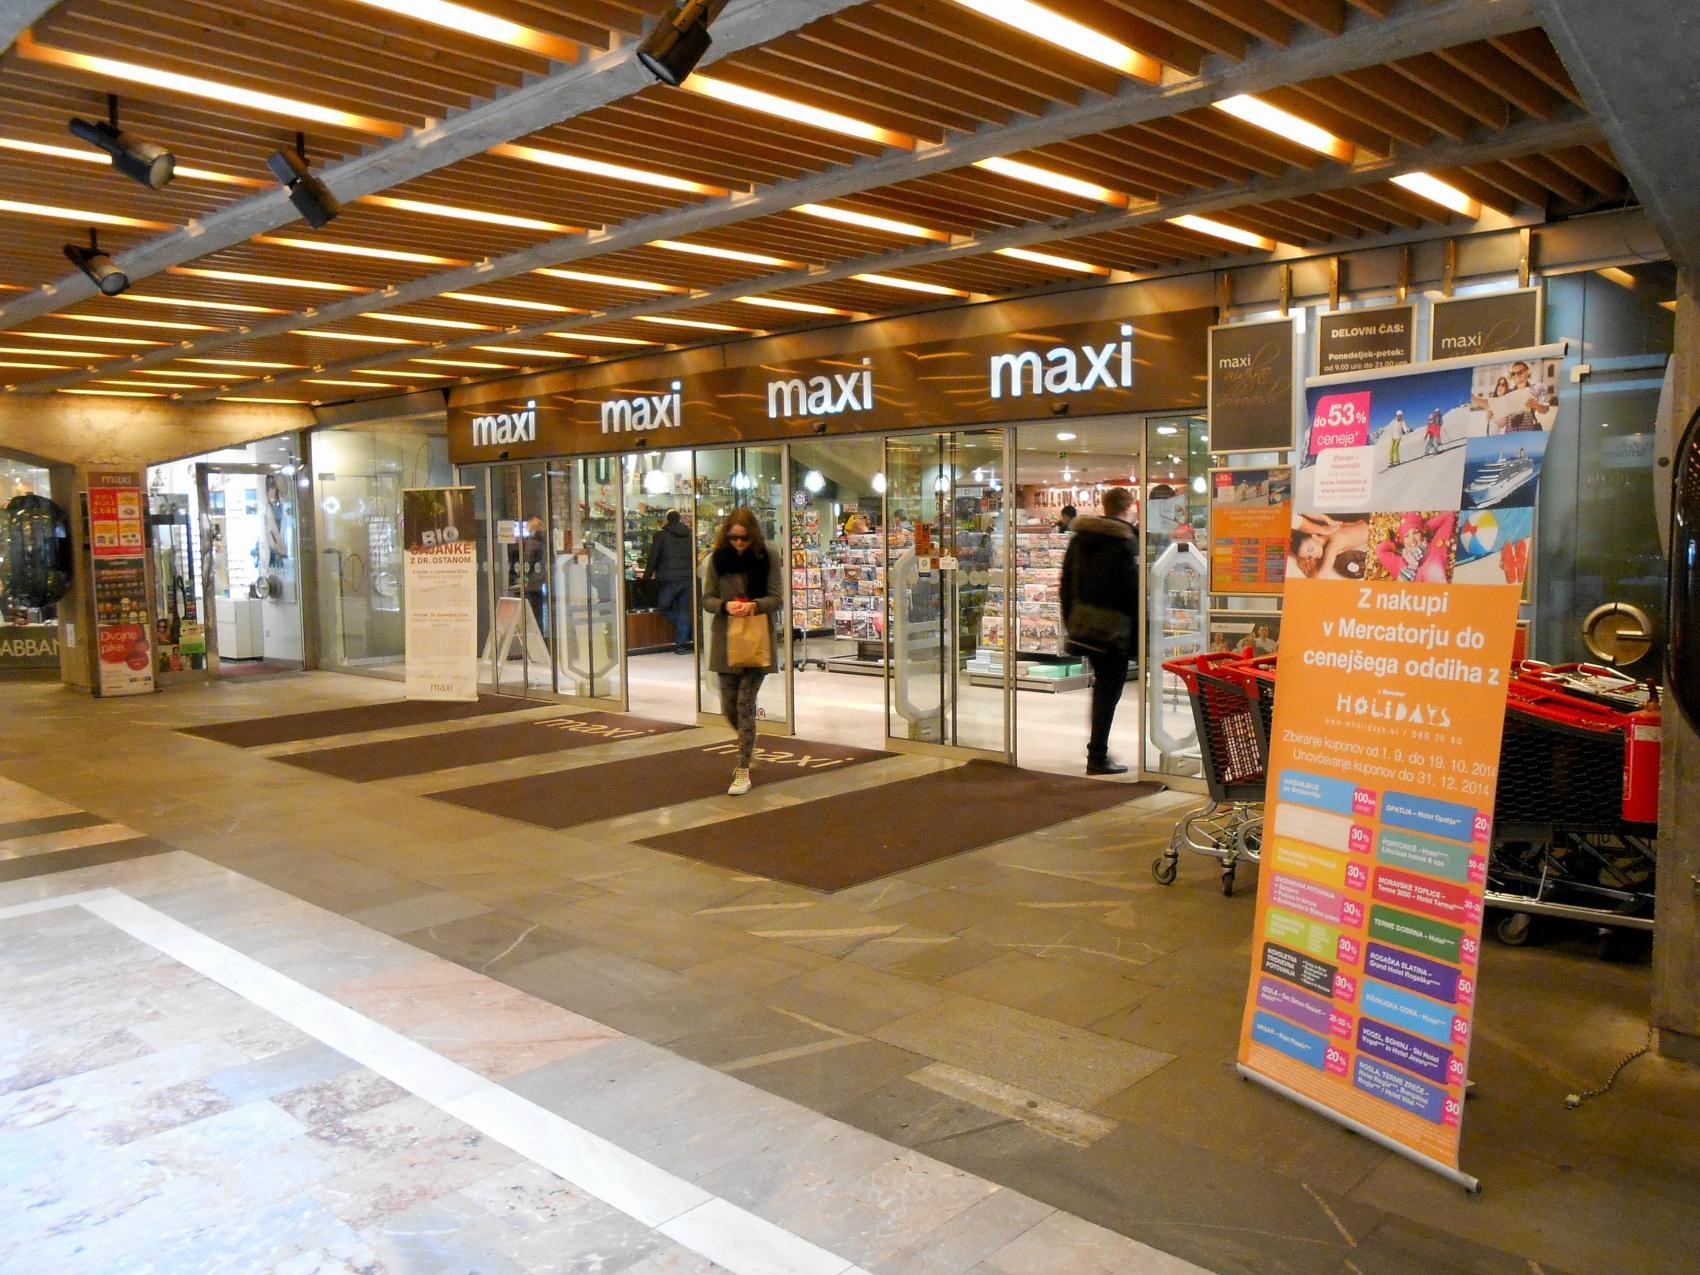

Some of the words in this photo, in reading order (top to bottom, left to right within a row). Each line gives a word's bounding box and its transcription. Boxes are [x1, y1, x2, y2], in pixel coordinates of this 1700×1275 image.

[1331, 327, 1376, 338] DELOVNI
[1379, 323, 1404, 334] ČAS:
[1441, 331, 1482, 349] maxi
[990, 324, 1132, 397] maxi
[1219, 353, 1252, 369] maxi
[1328, 348, 1404, 361] Ponedeljek-petek:
[1323, 363, 1334, 372] od
[1335, 362, 1349, 371] 9.00
[1363, 361, 1373, 370] do
[768, 357, 872, 418] maxi
[601, 380, 681, 434] maxi
[472, 400, 536, 446] maxi
[1313, 415, 1326, 428] do
[102, 475, 131, 484] maxi
[421, 525, 459, 546] BIO
[432, 556, 471, 564] OSTANOM
[1357, 588, 1372, 608] Z
[1376, 589, 1449, 616] nakupi
[101, 631, 137, 642] Dvojne
[1323, 621, 1334, 636] v
[1338, 617, 1449, 649] Mercatorju
[1456, 626, 1485, 649] do
[1303, 649, 1399, 678] cenejšega
[1405, 657, 1482, 684] oddiha
[1488, 668, 1500, 685] z
[430, 683, 453, 692] maxi
[534, 718, 655, 738] maxi
[1282, 729, 1323, 748] Zbiranje
[1324, 736, 1363, 756] kuponov
[1365, 744, 1379, 758] od
[1382, 747, 1391, 760] 1.
[1394, 749, 1405, 762] 9.
[1408, 752, 1425, 765] do
[1429, 755, 1446, 770] 19.
[1451, 759, 1468, 774] 10.
[1292, 748, 1352, 771] Unovčevanje
[1353, 761, 1396, 780] kuponov
[1398, 767, 1414, 783] do
[1418, 772, 1435, 786] 31.
[1441, 776, 1457, 791] 12.
[1461, 780, 1489, 797] 2014
[1354, 791, 1369, 804] 100
[1474, 817, 1487, 830] 20
[1378, 876, 1414, 891] MORAVSKE
[1414, 886, 1441, 899] TOPLICE
[1378, 884, 1396, 895] Terme
[1416, 894, 1433, 905] Hotel
[1374, 918, 1396, 930] TERME
[1463, 939, 1476, 953] 35
[1265, 961, 1296, 977] POTOVANJA
[1369, 959, 1388, 971] Grand
[1388, 965, 1404, 977] Hotel
[1370, 952, 1400, 967] ROGAŠKA
[1401, 962, 1428, 976] SLATINA
[1458, 979, 1472, 994] 50
[1454, 1019, 1467, 1034] 30
[1362, 1028, 1384, 1042] VOGEL,
[1384, 1036, 1408, 1051] BOHINJ
[1423, 1051, 1440, 1063] Hotel
[1392, 1047, 1409, 1058] Hotel
[1449, 1059, 1463, 1075] 30
[1382, 1071, 1404, 1084] TERME
[1445, 1099, 1459, 1116] 30
